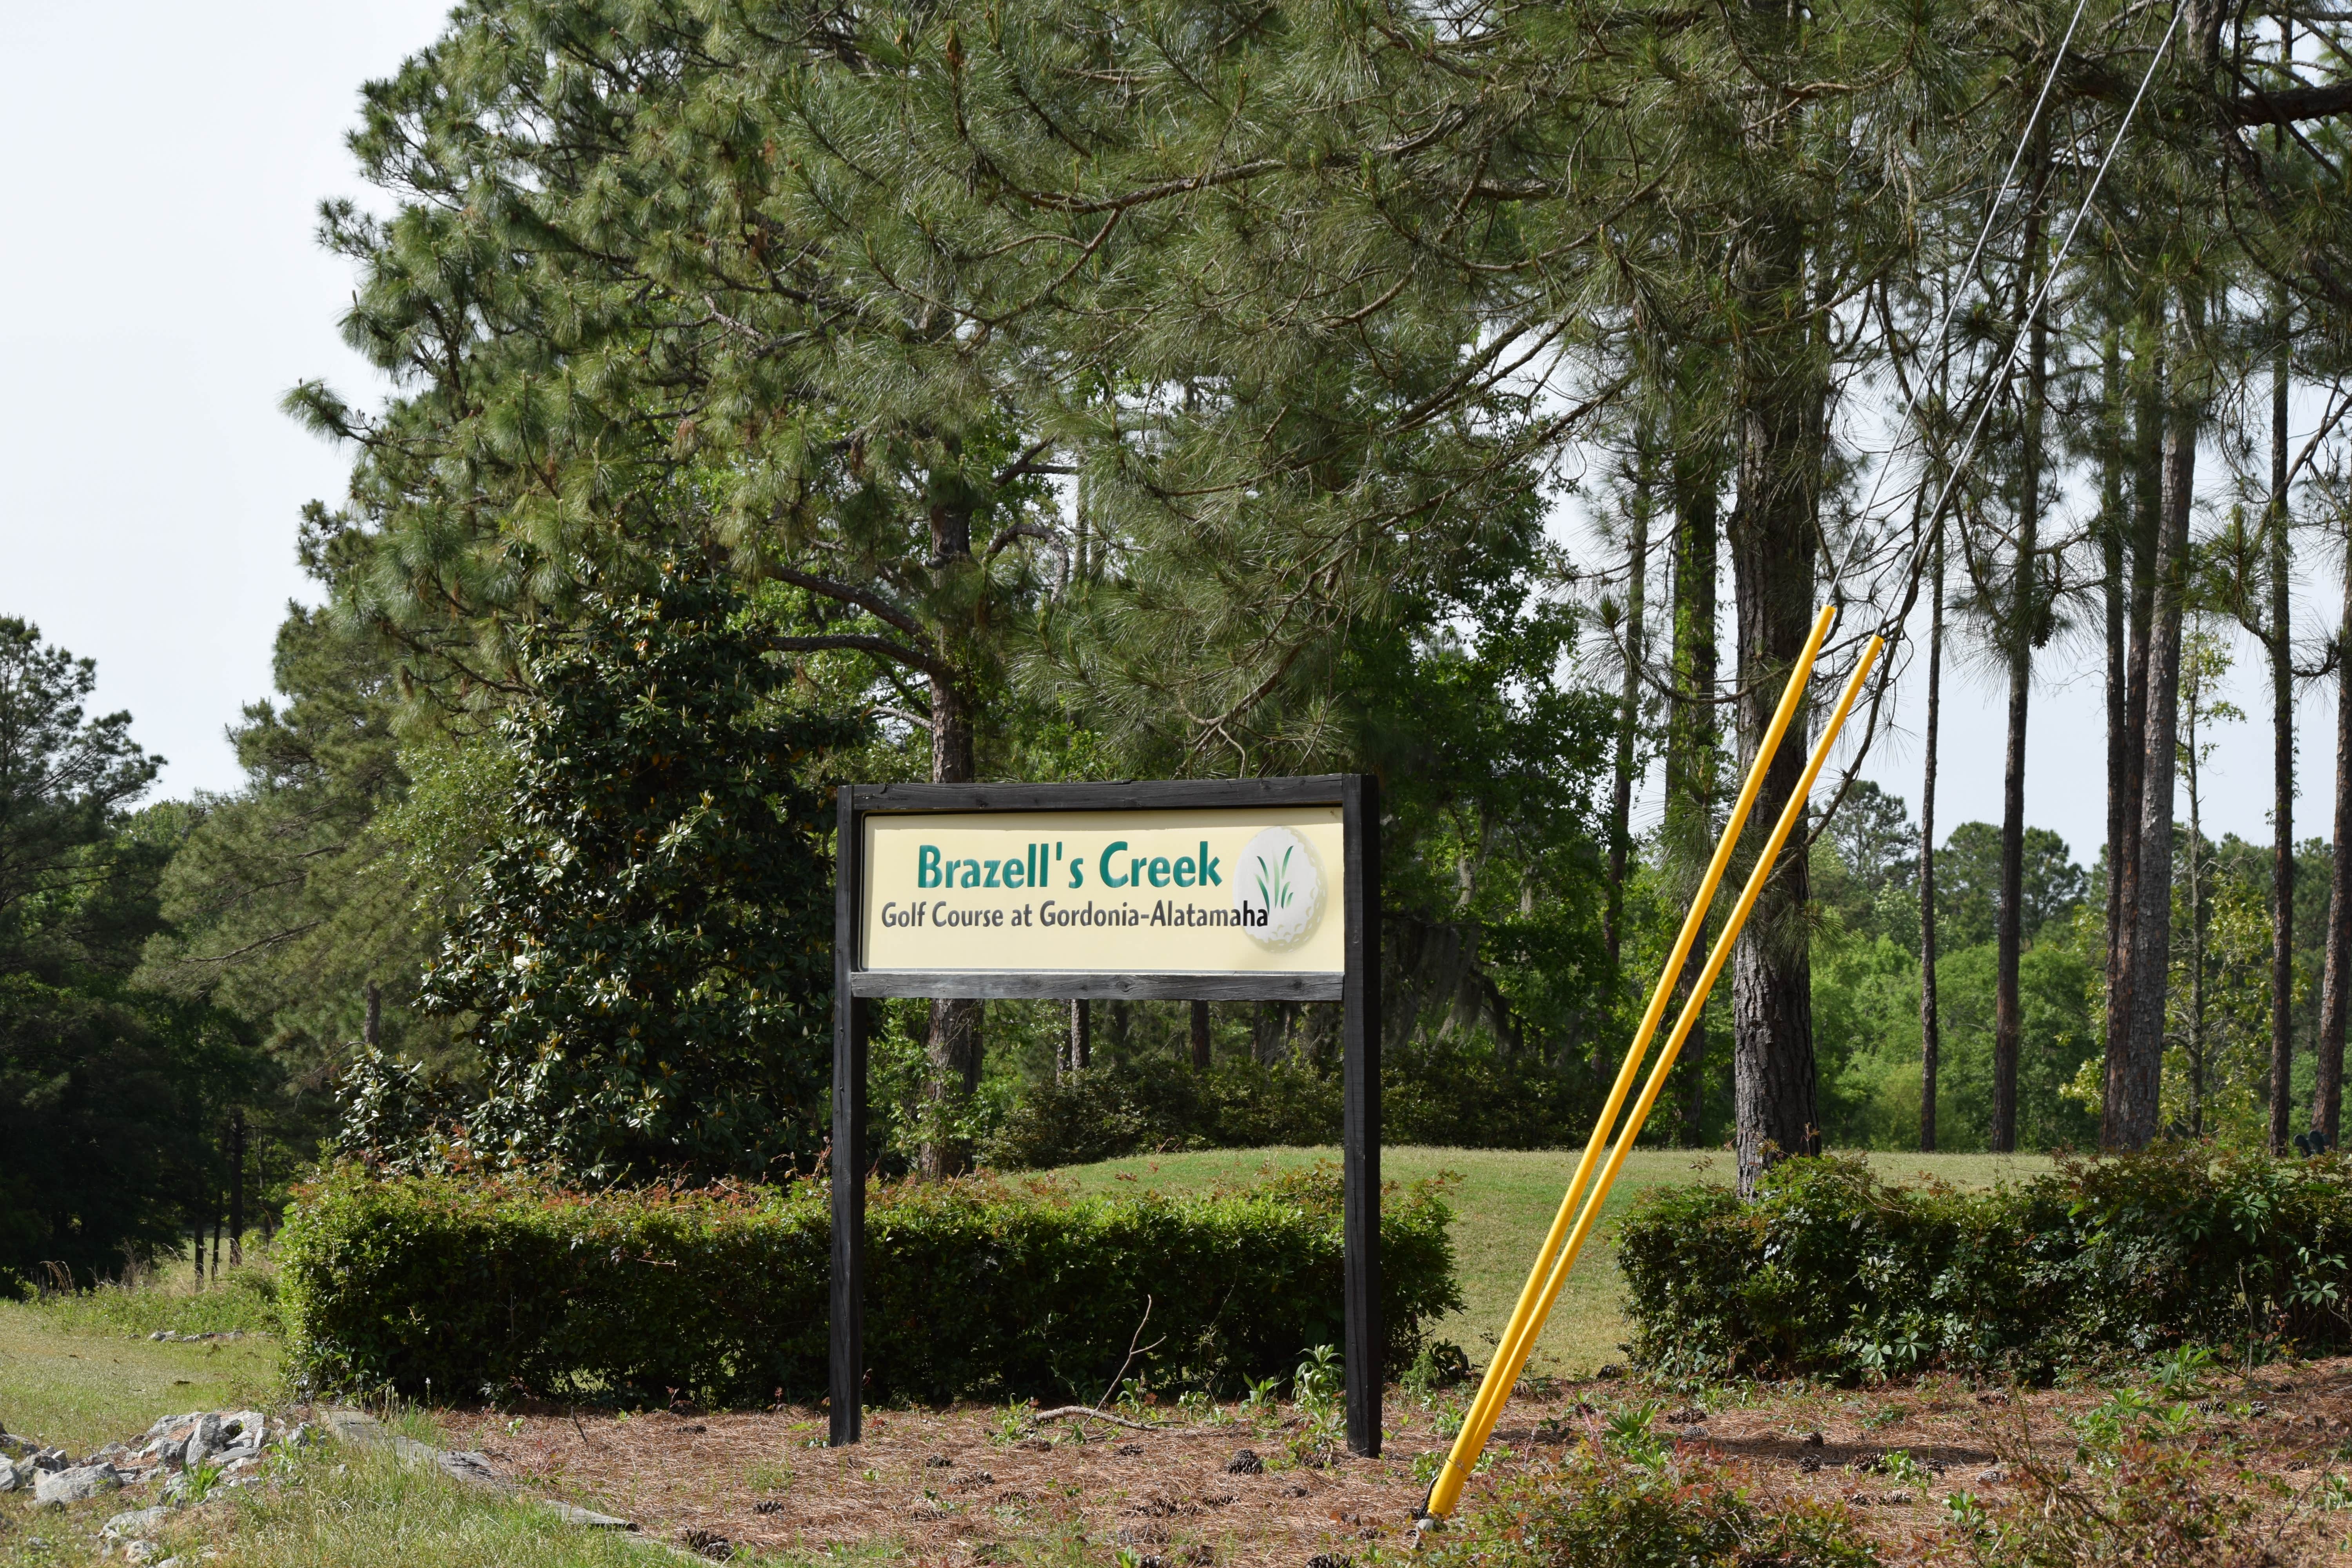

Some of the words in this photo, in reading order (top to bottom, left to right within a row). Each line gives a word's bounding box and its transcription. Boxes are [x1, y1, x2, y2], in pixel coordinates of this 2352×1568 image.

[918, 841, 1084, 889] Brazell's
[1099, 841, 1223, 887] Creek
[881, 901, 926, 927] Golf
[932, 901, 1004, 927] Course
[1011, 904, 1033, 927] at
[1039, 900, 1269, 927] Gordonia-Alatamaha
